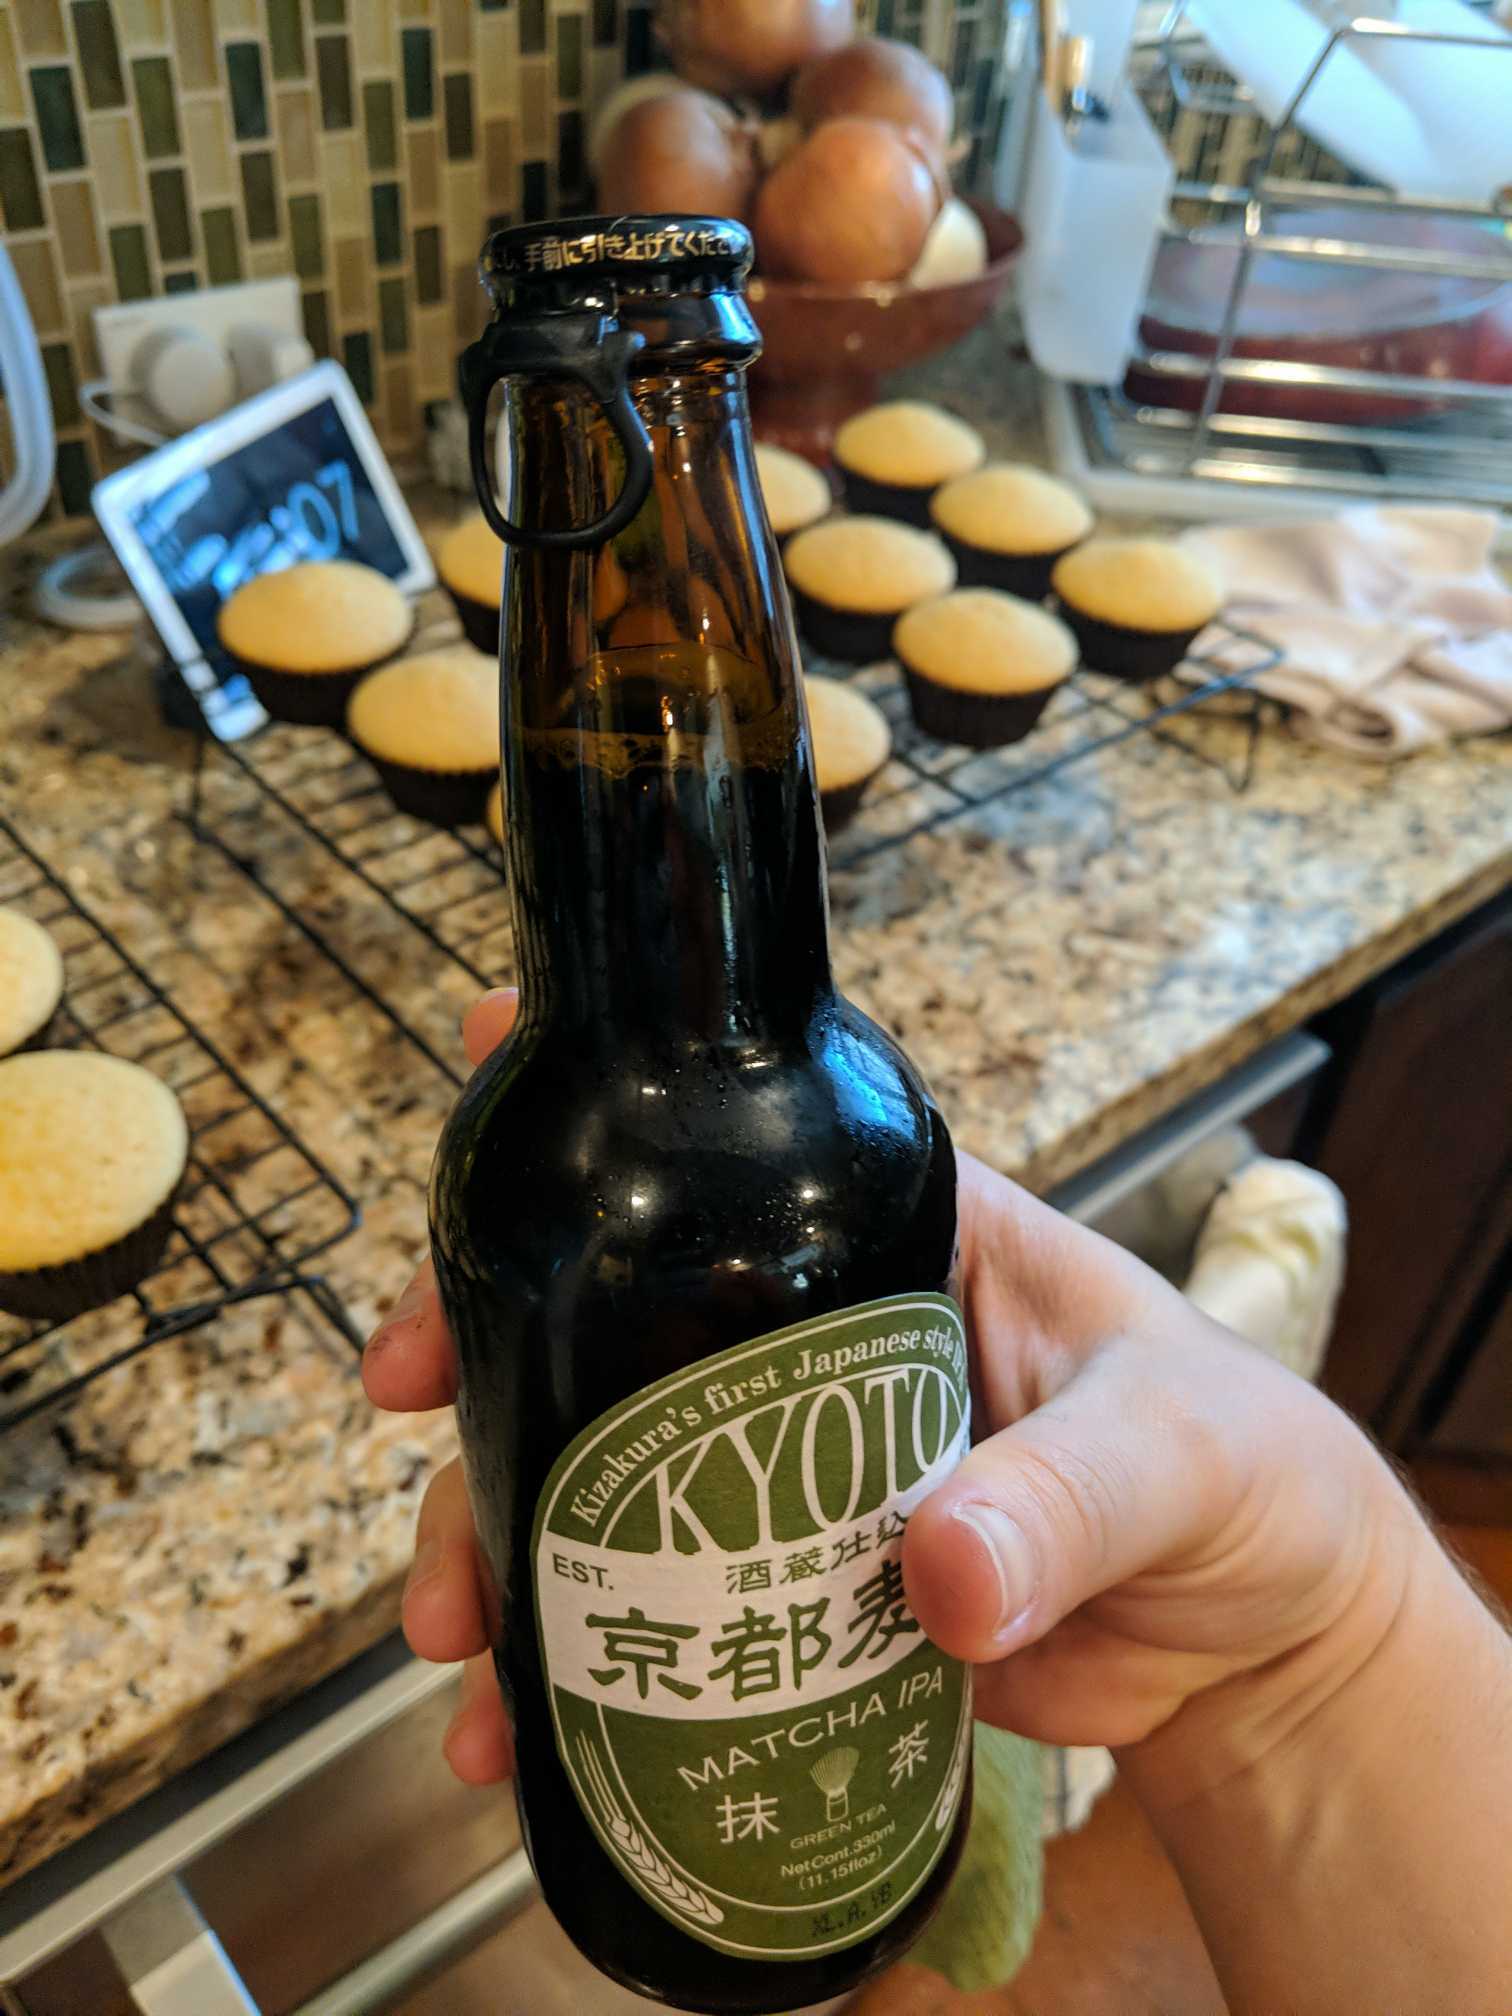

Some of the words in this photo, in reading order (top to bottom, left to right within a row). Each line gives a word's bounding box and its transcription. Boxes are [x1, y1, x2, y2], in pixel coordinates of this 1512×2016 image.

[570, 1406, 702, 1529] Kizakura's
[704, 1364, 782, 1416] first
[792, 1329, 921, 1382] Japanese
[922, 1324, 954, 1360] style
[652, 1367, 949, 1556] KYOTO
[552, 1552, 615, 1591] EST.
[677, 1691, 887, 1792] MATCHA
[897, 1666, 943, 1710] IPA
[789, 1820, 852, 1850] GREEN
[855, 1803, 888, 1826] TEA
